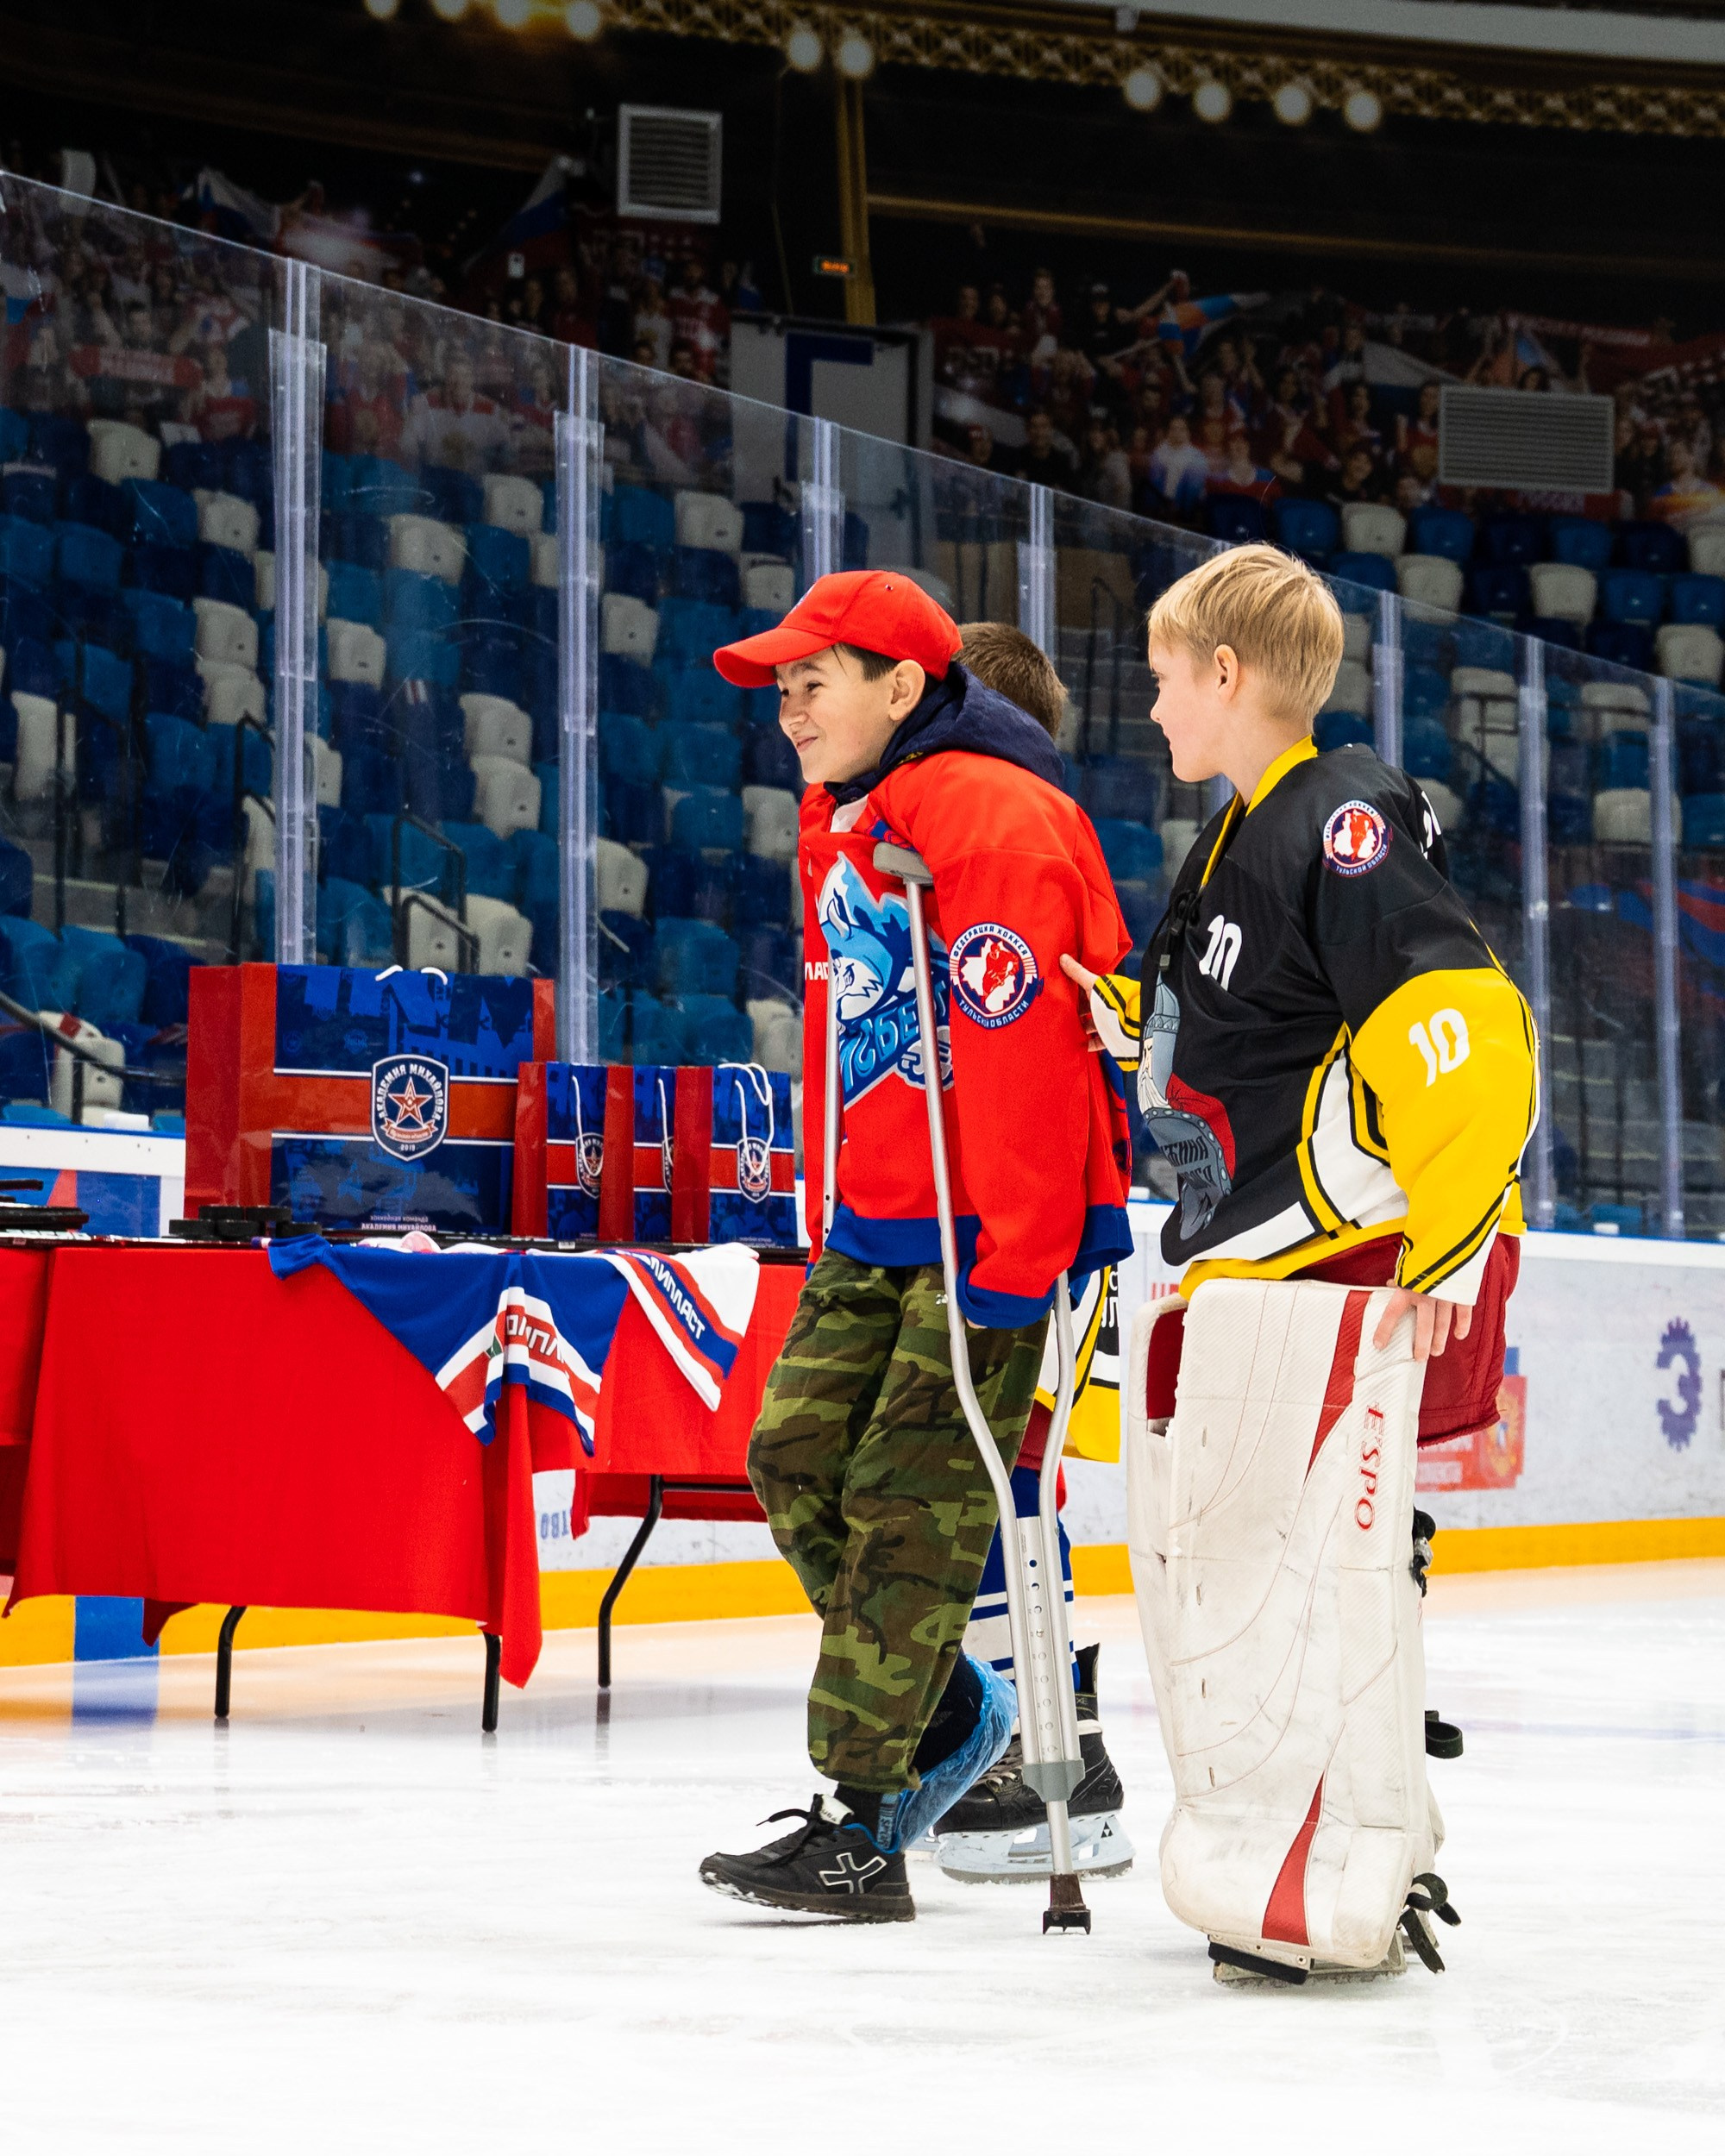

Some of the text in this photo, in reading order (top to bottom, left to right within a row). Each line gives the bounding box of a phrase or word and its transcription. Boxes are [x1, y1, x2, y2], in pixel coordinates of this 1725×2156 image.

[952, 925, 1029, 957] ФЕДЕРАЦИЯ ХОККЕЯ
[1199, 914, 1242, 992] 10
[989, 1000, 1030, 1027] ОБЛАСТИ
[1408, 1007, 1471, 1088] 10
[376, 1063, 444, 1120] АКАДЕМИЯ МИХАЙЛОВА
